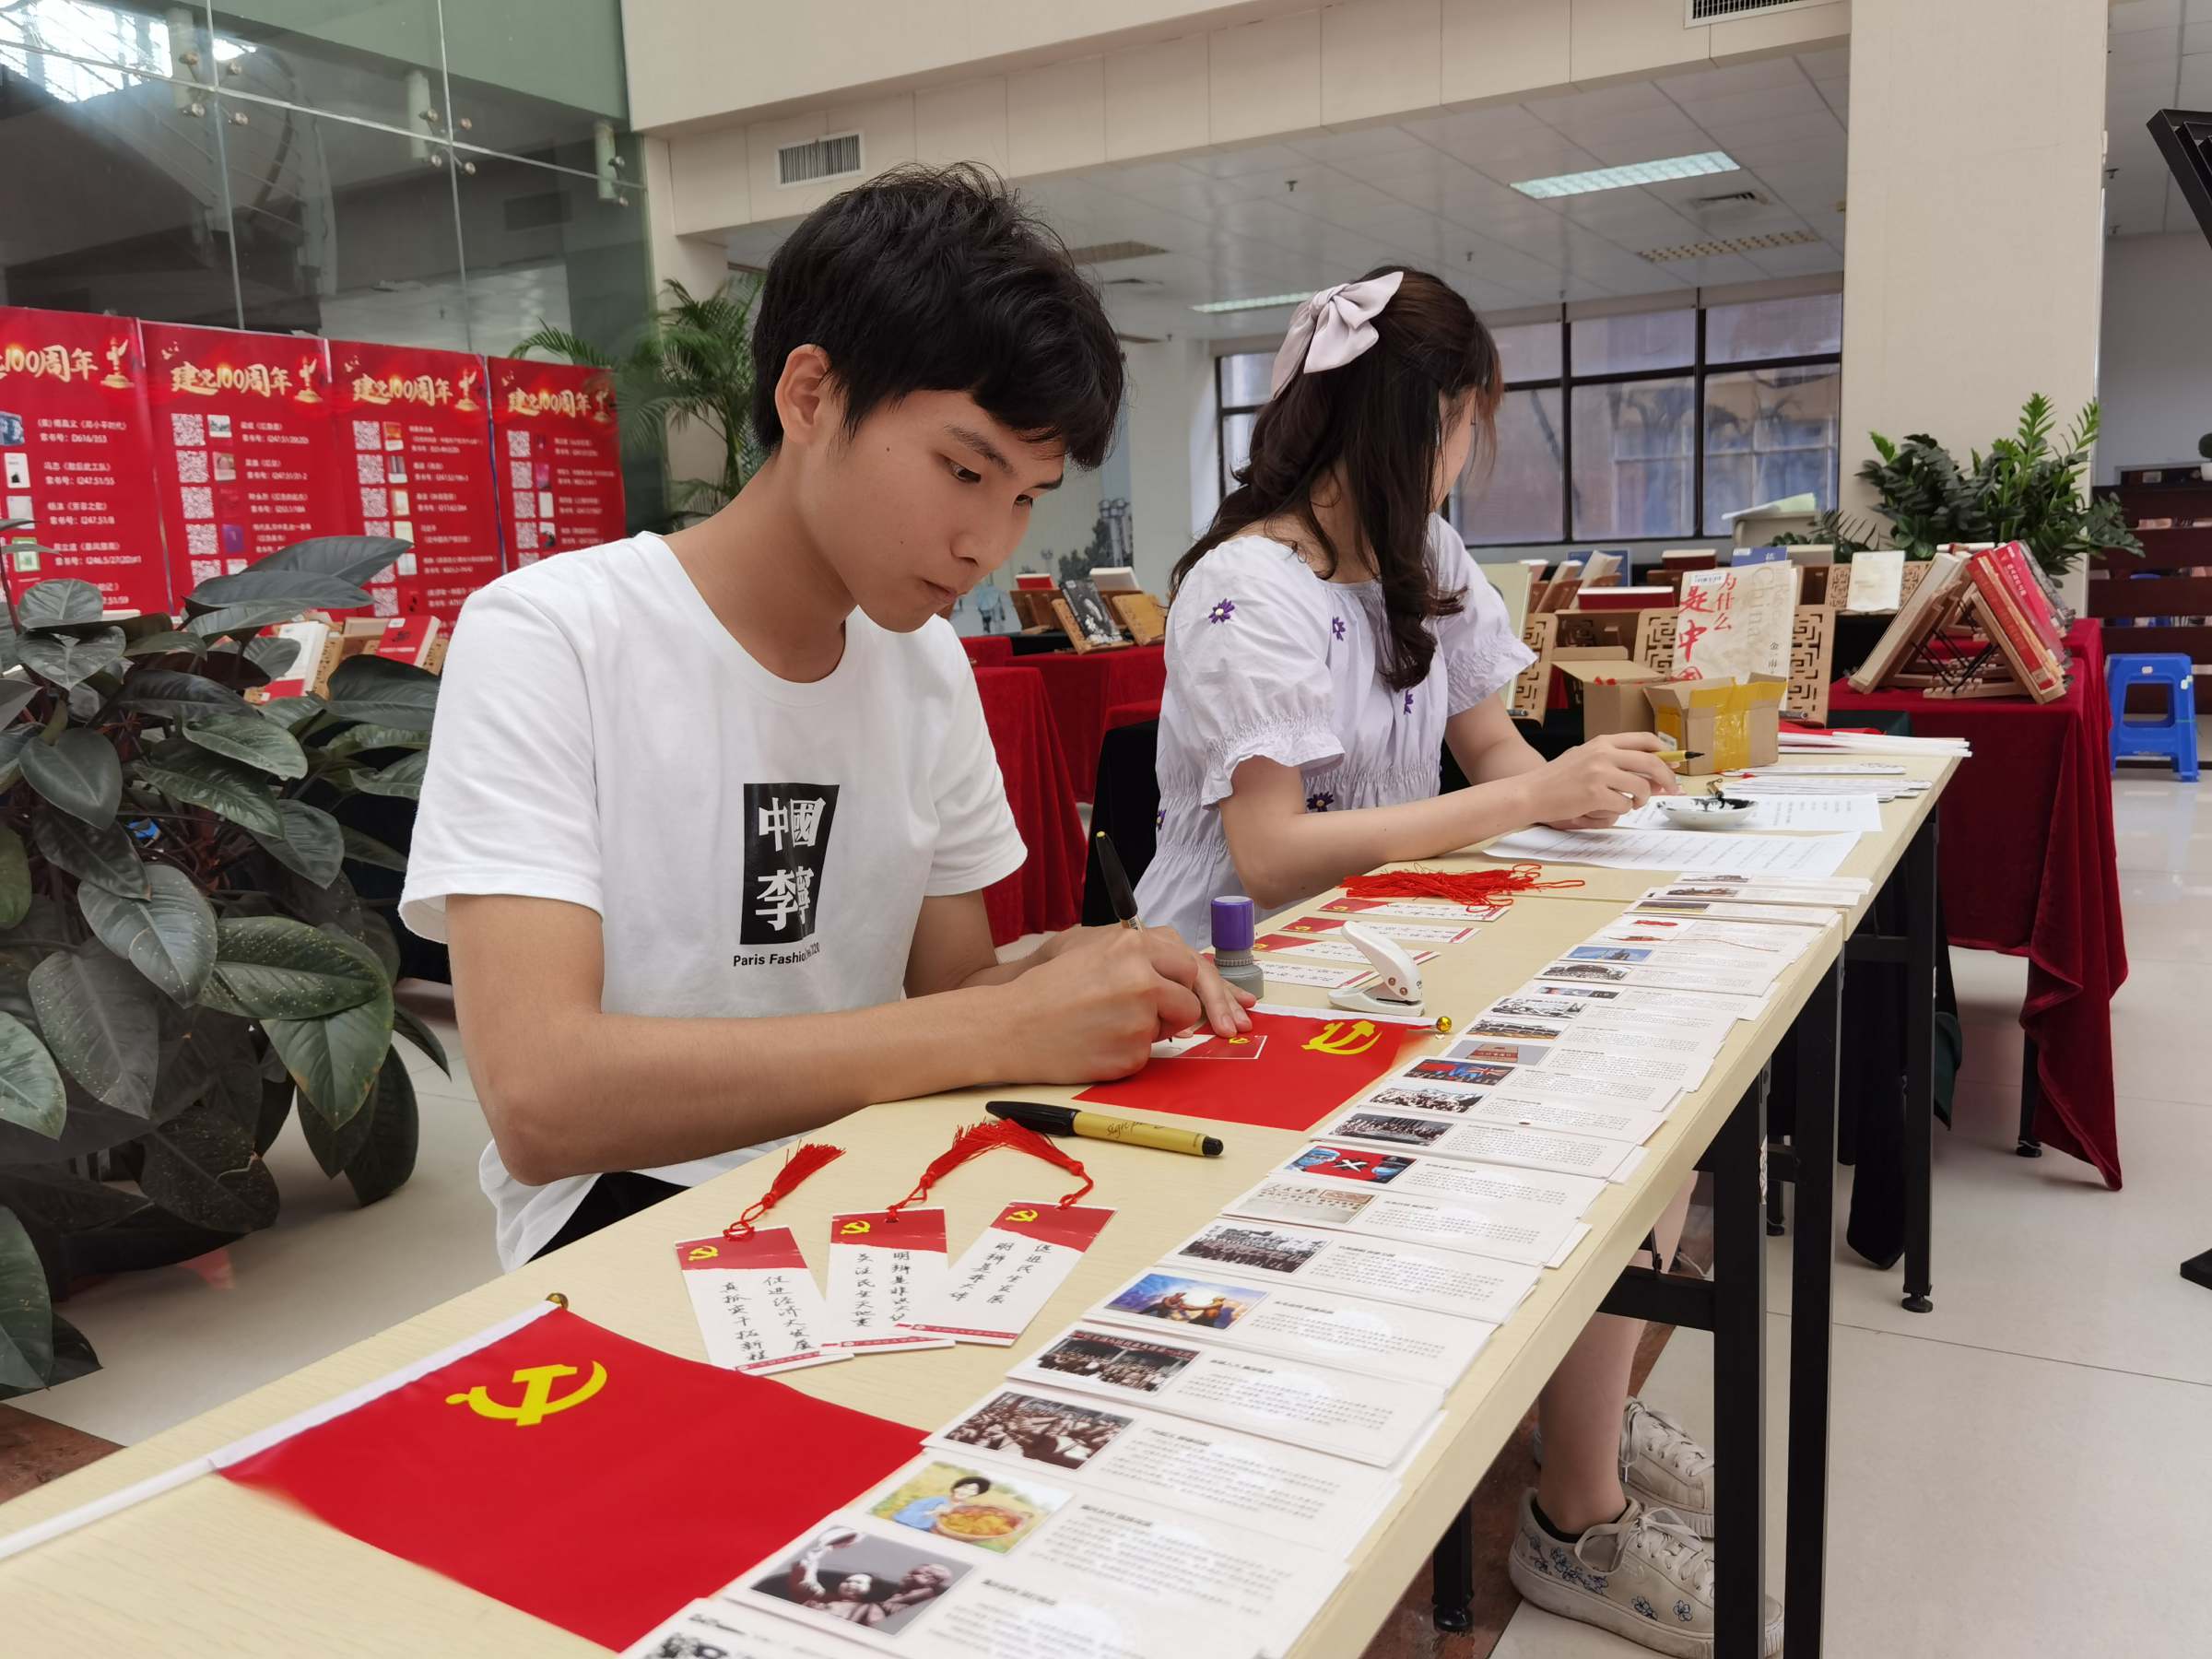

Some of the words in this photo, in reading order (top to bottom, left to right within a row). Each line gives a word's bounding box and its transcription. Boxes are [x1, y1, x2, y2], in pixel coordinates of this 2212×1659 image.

[0, 345, 99, 382] 100周年
[1713, 572, 1737, 630] 为什么
[759, 797, 826, 852] 中國
[733, 953, 765, 967] Paris
